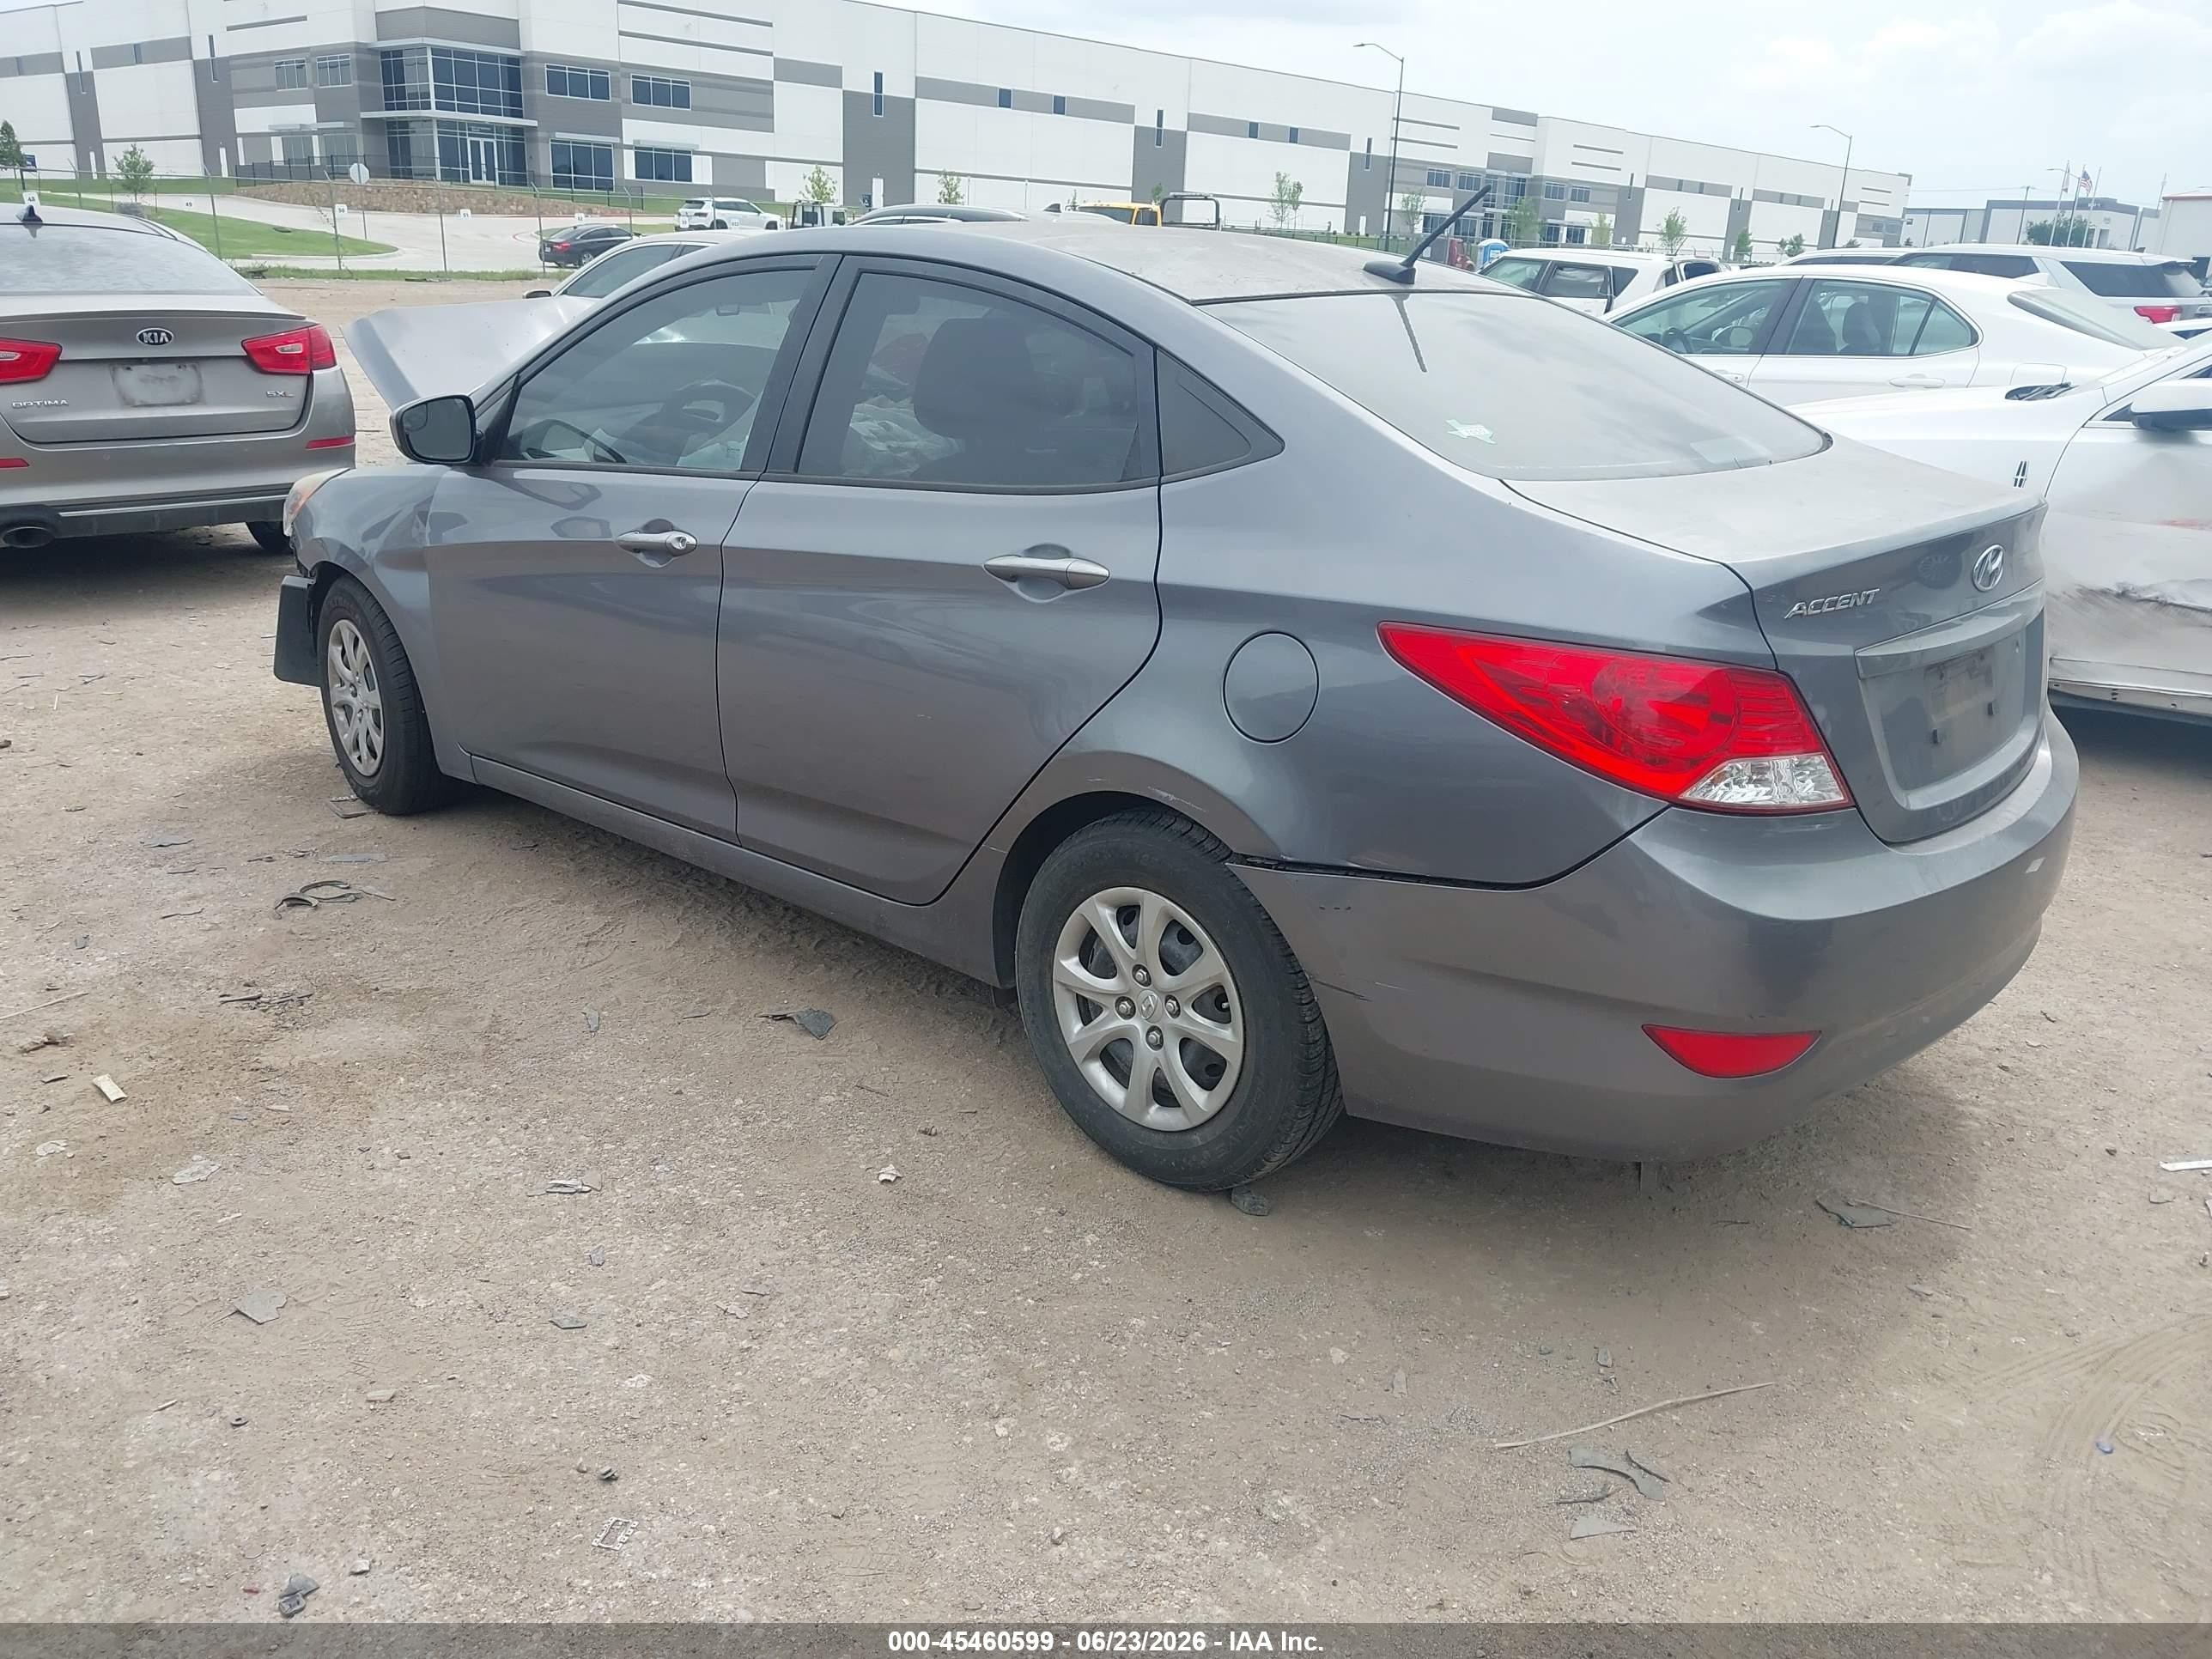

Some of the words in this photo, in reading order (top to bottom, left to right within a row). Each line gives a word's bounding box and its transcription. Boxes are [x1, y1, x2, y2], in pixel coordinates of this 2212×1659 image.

[143, 332, 169, 343] KIA
[11, 399, 70, 409] OPTIMA
[1784, 588, 1881, 619] ACCENT
